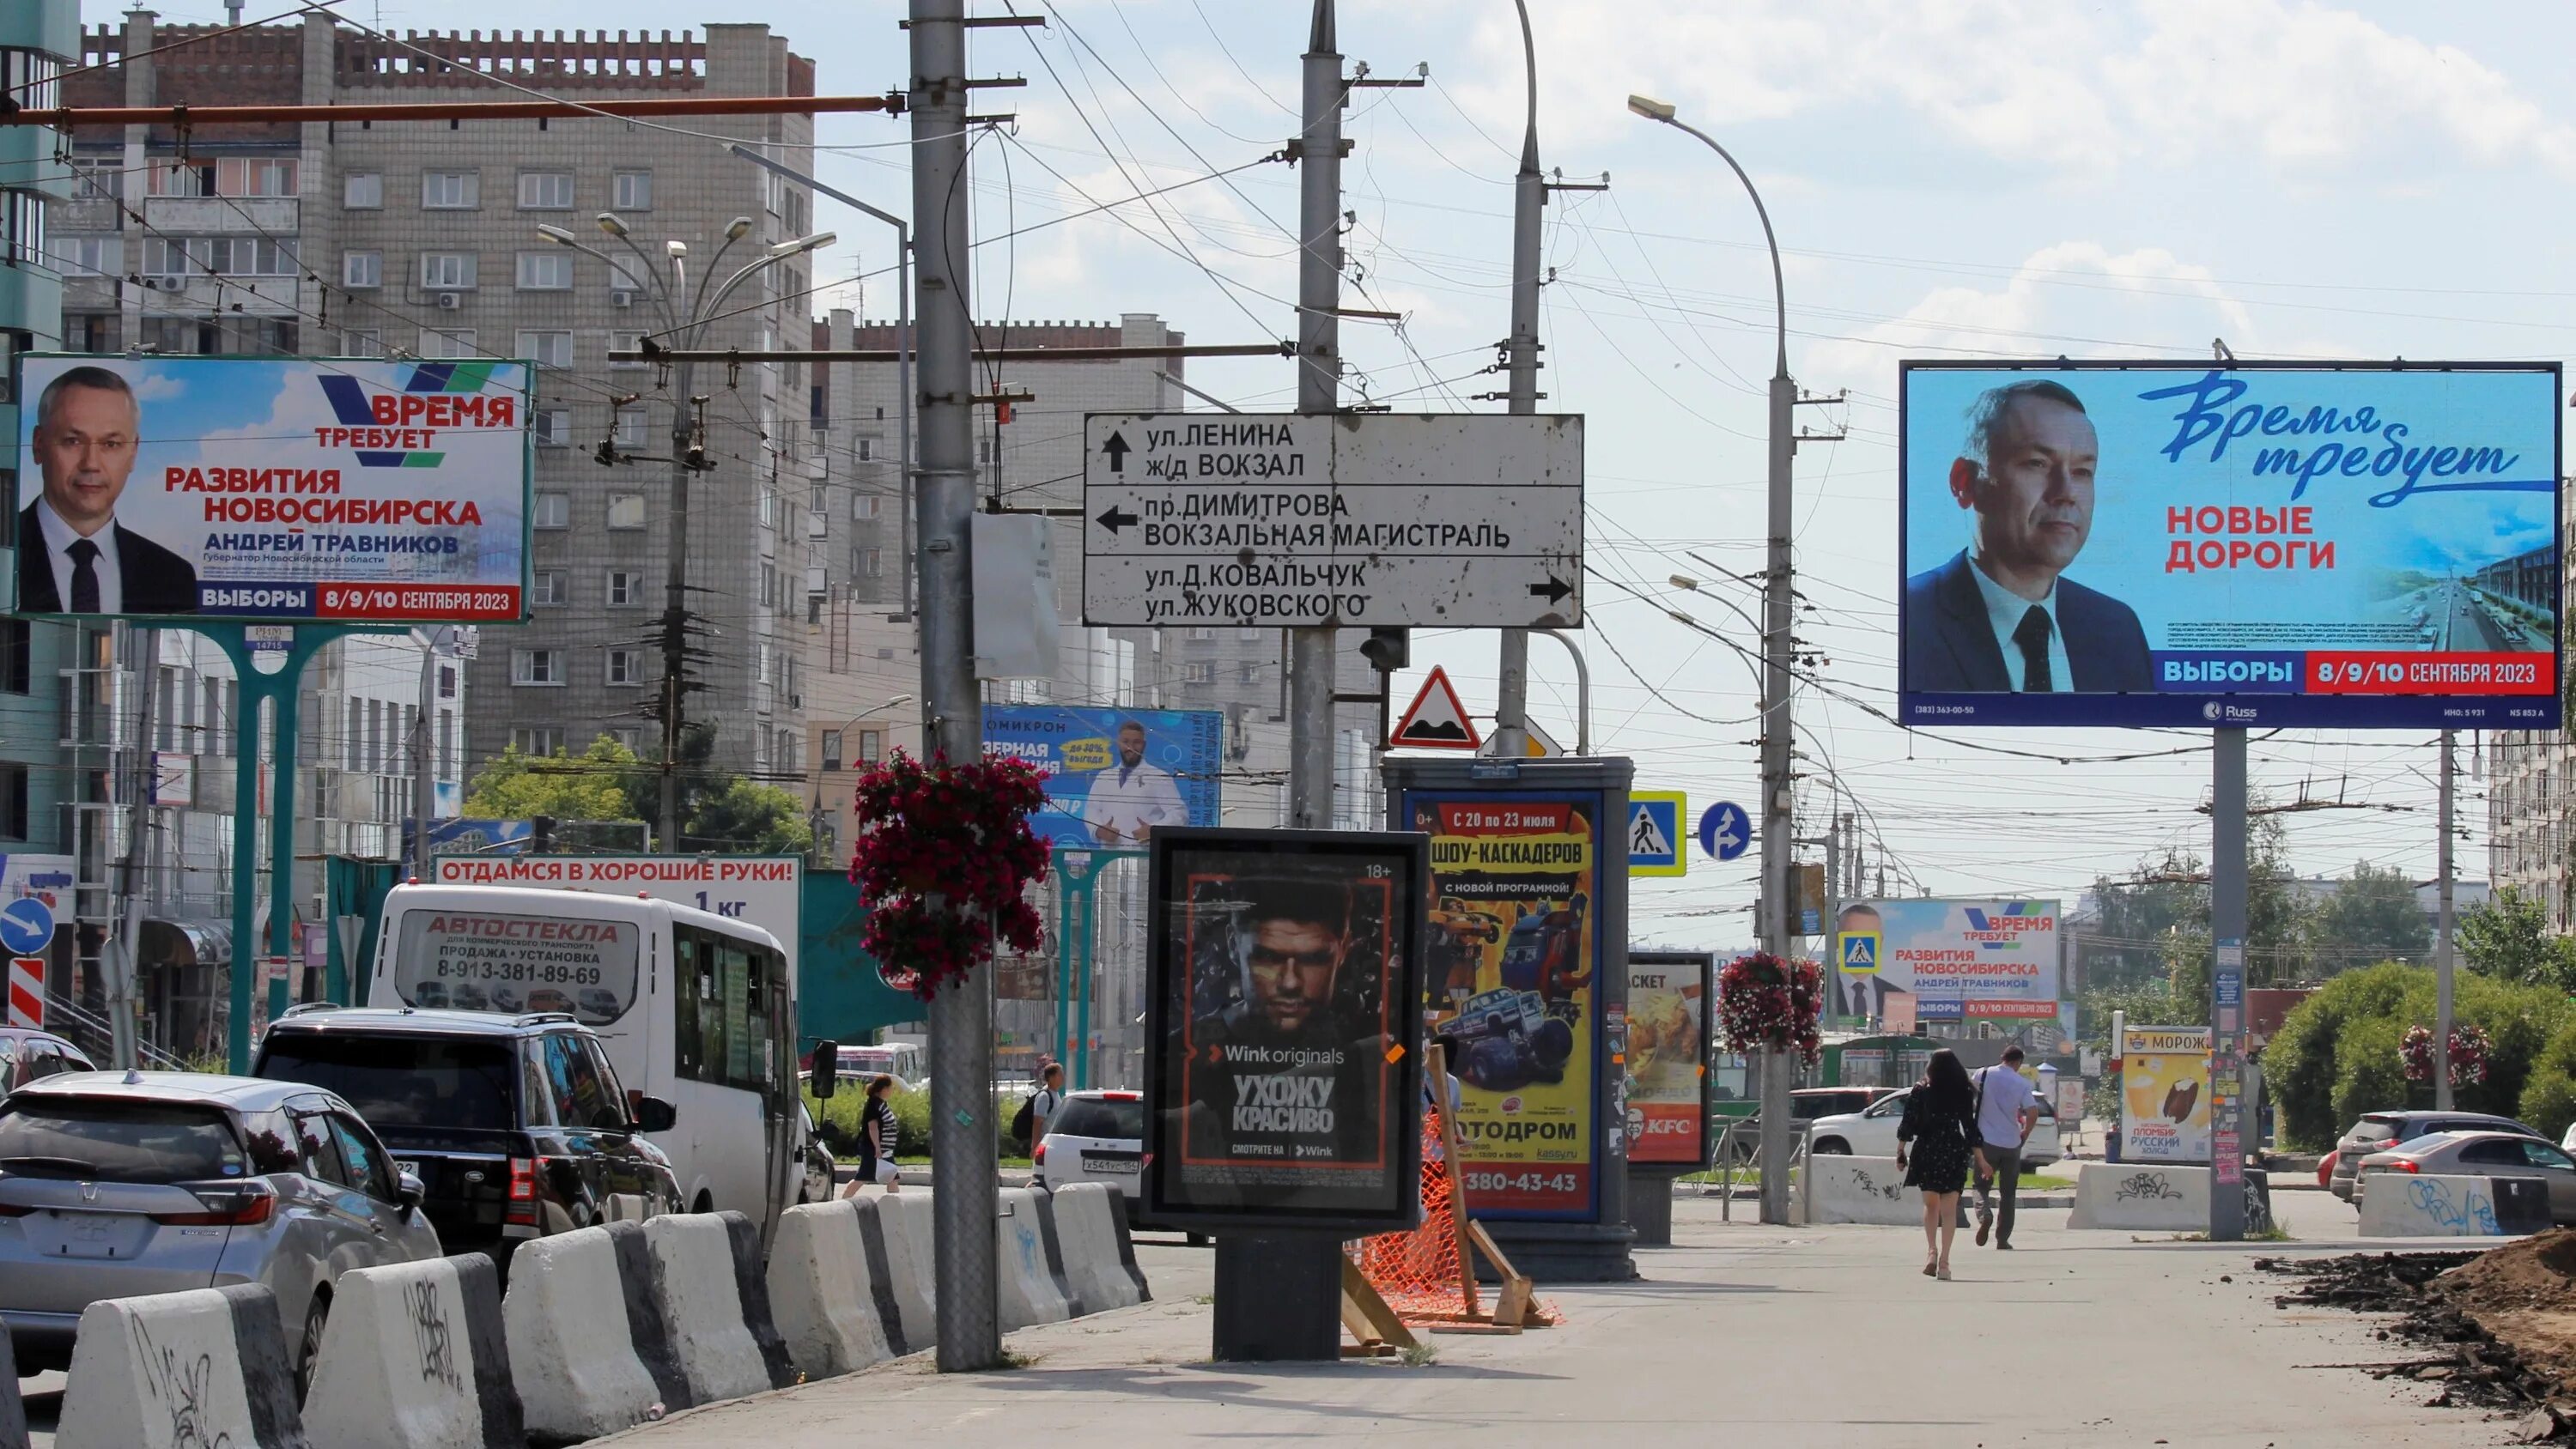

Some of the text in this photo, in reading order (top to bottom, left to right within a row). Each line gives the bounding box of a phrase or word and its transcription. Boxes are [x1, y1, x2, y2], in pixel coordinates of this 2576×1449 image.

[372, 395, 513, 427] ВРЕМЯ
[2136, 371, 2381, 463] Время
[314, 427, 435, 449] ТРЕБУЕТ
[1146, 424, 1293, 452] ул.ЛЕНИНА
[1146, 453, 1303, 480] ж/д ВОКЗАЛ
[2252, 423, 2555, 507] требует
[166, 467, 340, 494] РАЗВИТИЯ
[204, 497, 482, 526] НОВОСИБИРСКА
[1145, 494, 1348, 520] пр.ДИМИТРОВА
[2166, 506, 2313, 534] НОВЫЕ
[204, 530, 459, 554] АНДРЕЙ ТРАВНИКОВ
[1145, 524, 1510, 549] ВОКЗАЛЬНАЯ МАГИСТРАЛЬ
[204, 553, 385, 564] Губернатор Новосибирской области
[2165, 542, 2335, 573] ДОРОГИ
[202, 589, 509, 610] ВЫБОРЫ 8/9/10 СЕНТЯБРЯ 2023
[1145, 594, 1365, 622] ул.ЖУКОВСКОГО
[2163, 660, 2536, 685] ВЫБОРЫ 8/9/10 СЕНТЯБРЯ 2023
[1915, 705, 1974, 714] (383) 363-00-50
[2226, 706, 2257, 718] Russ
[987, 720, 1066, 733] ОМИКРОН
[982, 741, 1048, 757] ЗЕРНАЯ
[1417, 814, 1432, 825] 0+
[1453, 812, 1555, 828] С 20 по 23 июля
[1431, 842, 1582, 865] ШОУ-КАСКАДЕРОВ
[442, 862, 793, 882] ОТДАМСЯ В ХОРОШИЕ РУКИ!
[1366, 864, 1391, 878] 18+
[1445, 882, 1570, 894] С НОВОЙ ПРОГРАММОЙ!
[719, 900, 747, 917] кг
[427, 916, 618, 943] АВТОСТЕКЛА
[1988, 916, 2053, 931] ВРЕМЯ
[1963, 931, 2018, 942] ТРЕБУЕТ
[440, 945, 600, 964] ПРОДАЖА УСТАНОВКА
[1895, 949, 1975, 961] РАЗВИТИЯ
[437, 959, 600, 985] 8-913-381-89-69
[1913, 962, 2039, 976] НОВОСИБИРСКА
[1914, 978, 2029, 988] АНДРЕЙ ТРАВНИКОВ
[2153, 1036, 2212, 1049] МОРОЖ
[1224, 1045, 1345, 1068] Wink originals
[1233, 1075, 1336, 1107] УХОЖУ
[1232, 1106, 1334, 1133] КРАСИВО
[1646, 1119, 1691, 1134] KFC
[1232, 1143, 1284, 1155] СМОТРИТЕ НА
[1305, 1146, 1333, 1156] Wink
[2130, 1136, 2180, 1147] РУССКИЙ
[1467, 1173, 1577, 1191] 380-43-43
